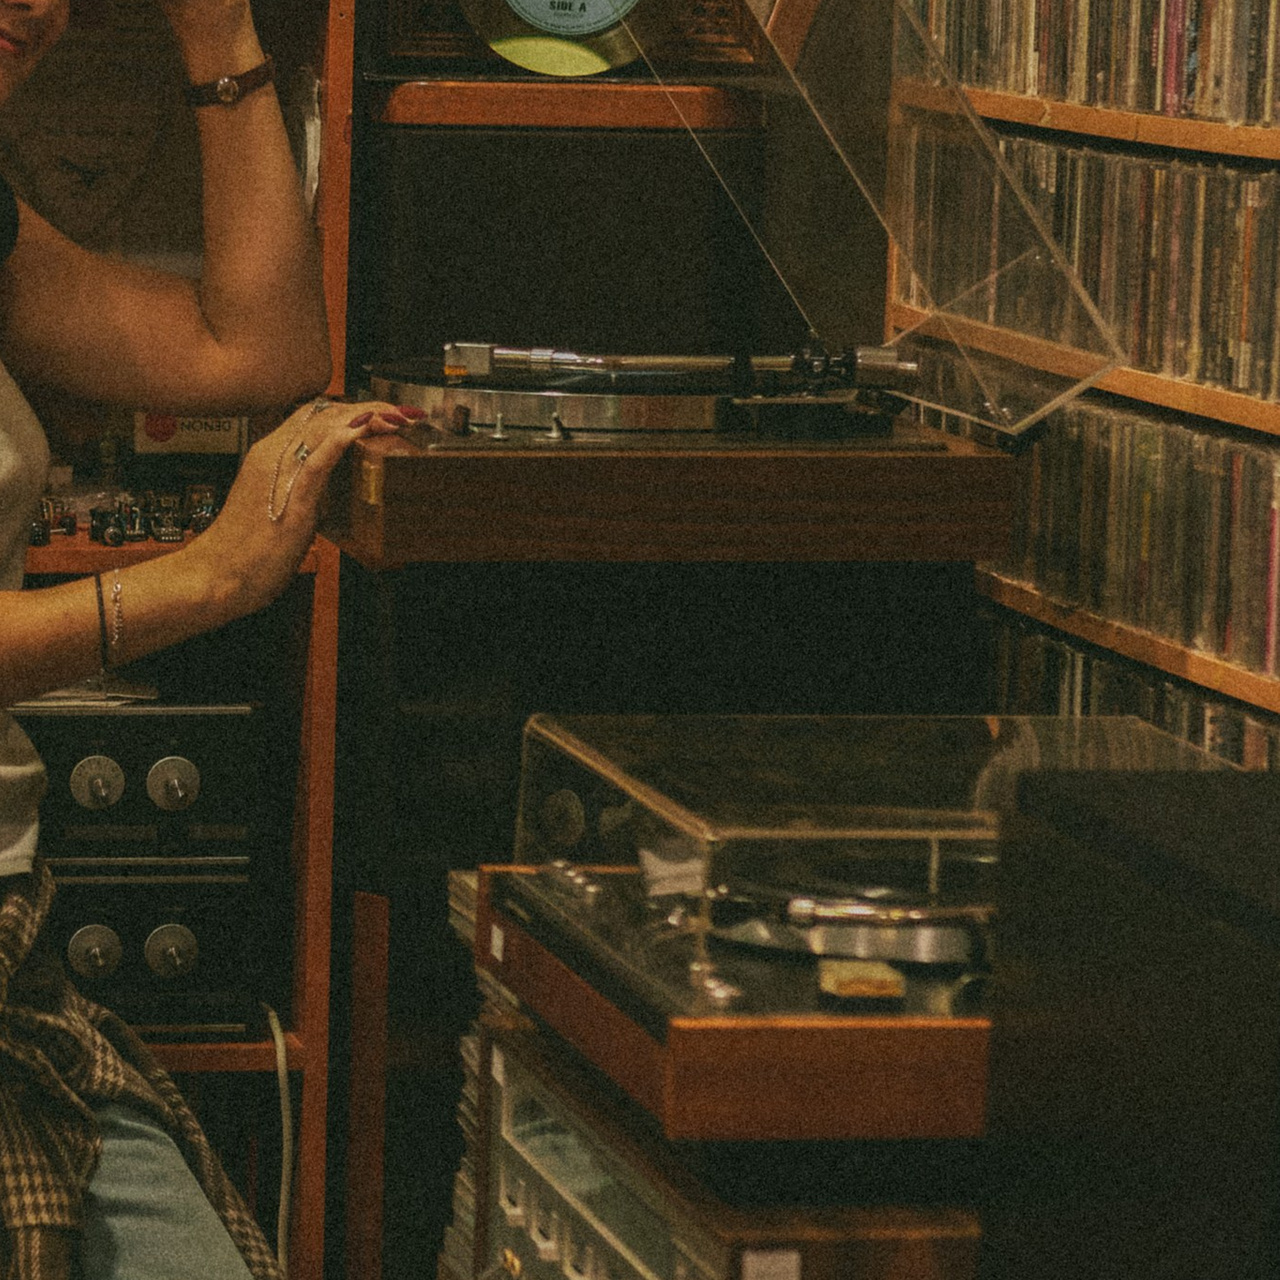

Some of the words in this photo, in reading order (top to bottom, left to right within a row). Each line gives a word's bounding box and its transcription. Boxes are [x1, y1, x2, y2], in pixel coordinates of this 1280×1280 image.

[548, 0, 574, 12] SIDE
[578, 1, 587, 12] A
[180, 420, 232, 432] DENON
